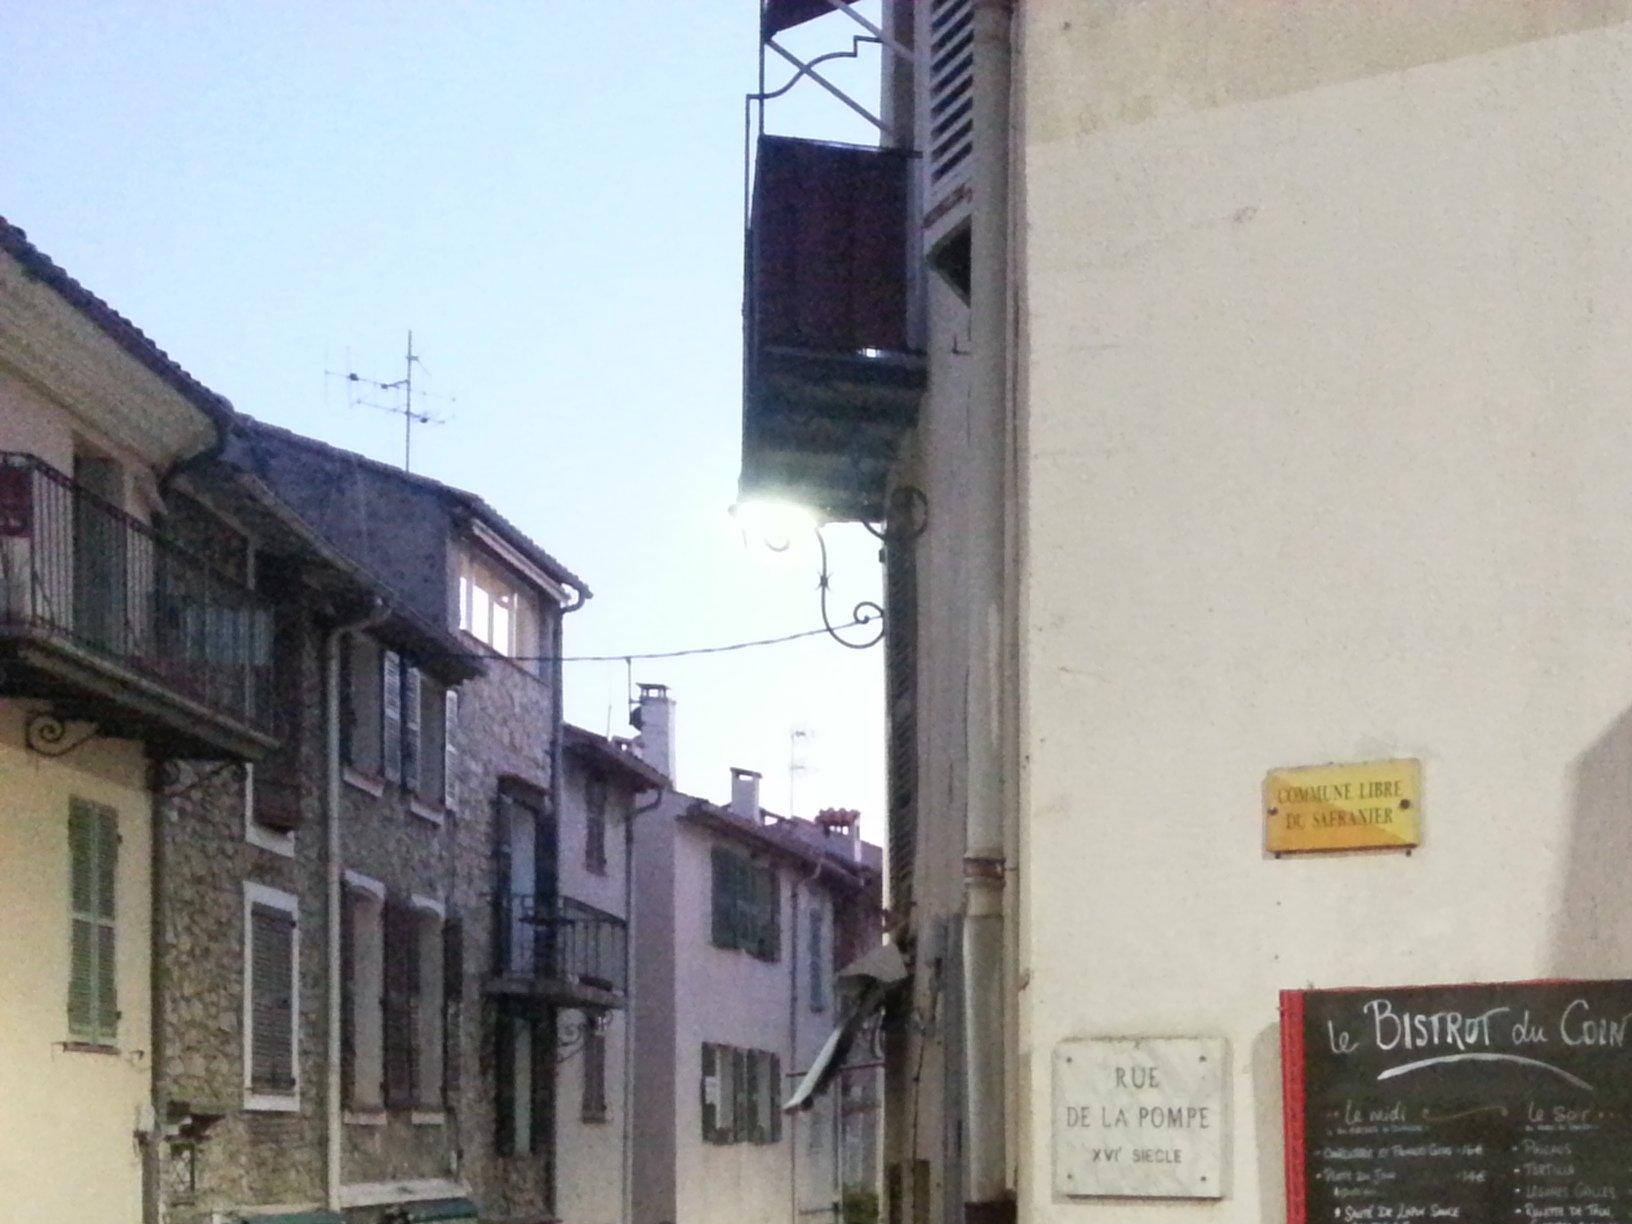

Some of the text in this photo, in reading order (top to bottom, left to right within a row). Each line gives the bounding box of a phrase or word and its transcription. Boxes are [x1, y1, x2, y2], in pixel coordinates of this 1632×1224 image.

[1278, 780, 1403, 804] COMMUNE LIBRE
[1285, 807, 1394, 830] DU SAFRANIER
[1364, 999, 1510, 1051] BISTROT
[1512, 1009, 1548, 1044] du
[1115, 1066, 1161, 1089] RUE
[1066, 1105, 1211, 1130] DE LA POMPE
[1370, 1101, 1406, 1122] midi
